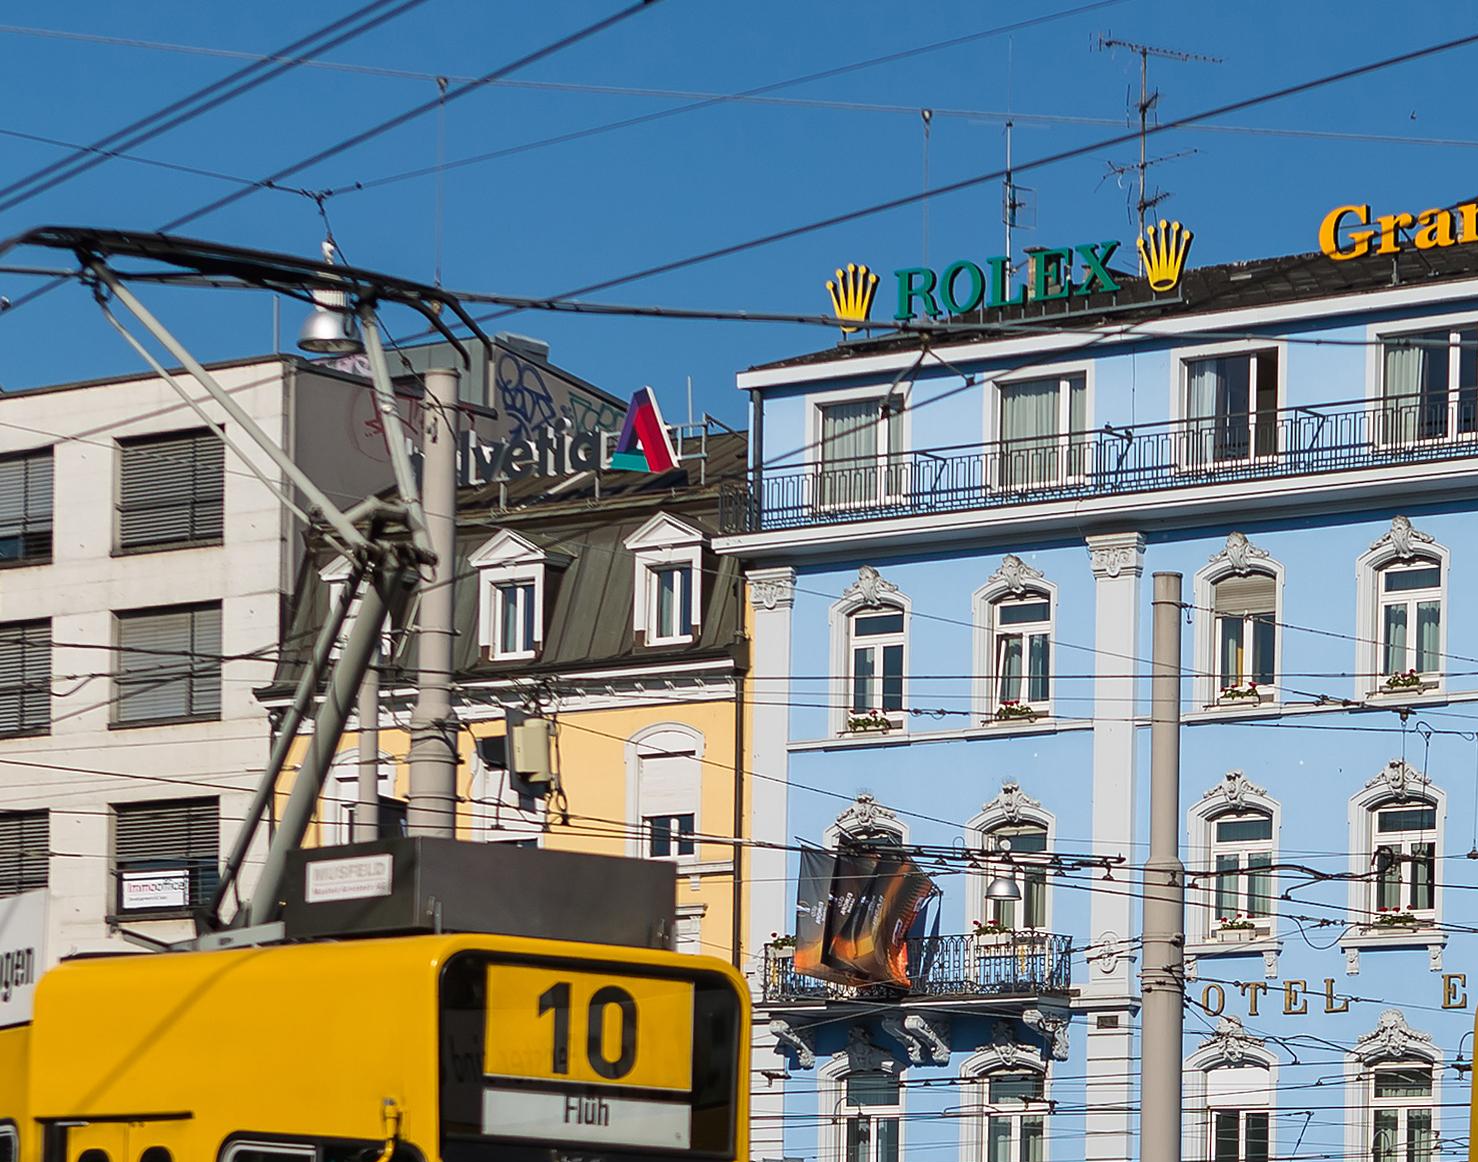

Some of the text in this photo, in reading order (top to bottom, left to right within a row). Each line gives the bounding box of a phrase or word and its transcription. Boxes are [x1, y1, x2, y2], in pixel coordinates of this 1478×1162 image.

[894, 240, 1121, 320] ROLEX
[0, 947, 34, 1003] gen
[1186, 977, 1350, 1017] OTEL
[537, 981, 638, 1080] 10
[563, 1093, 610, 1127] Flüh
